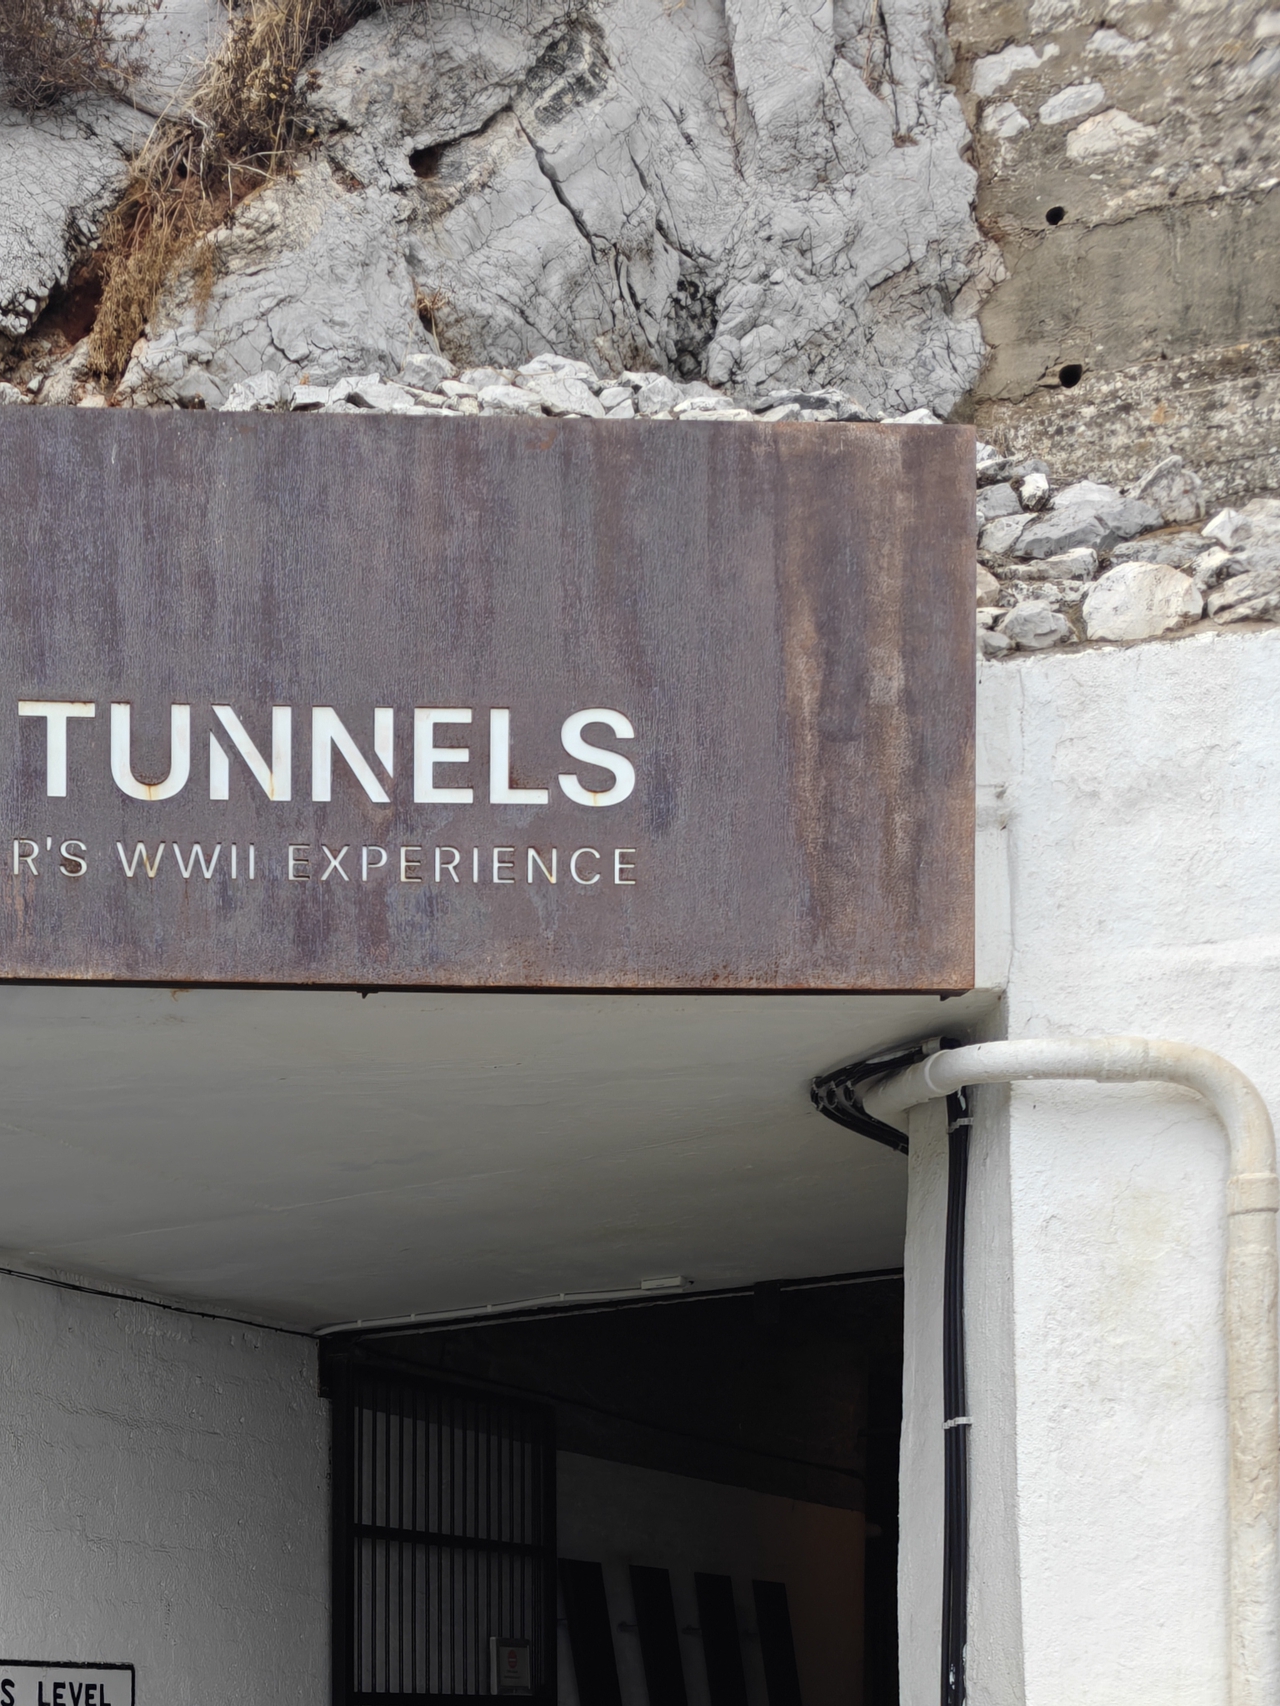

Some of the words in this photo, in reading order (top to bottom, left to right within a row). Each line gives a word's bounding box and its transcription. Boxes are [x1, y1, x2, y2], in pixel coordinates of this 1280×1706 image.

[19, 702, 636, 807] TUNNELS
[117, 842, 254, 880] WWII
[289, 846, 636, 884] EXPERIENCE
